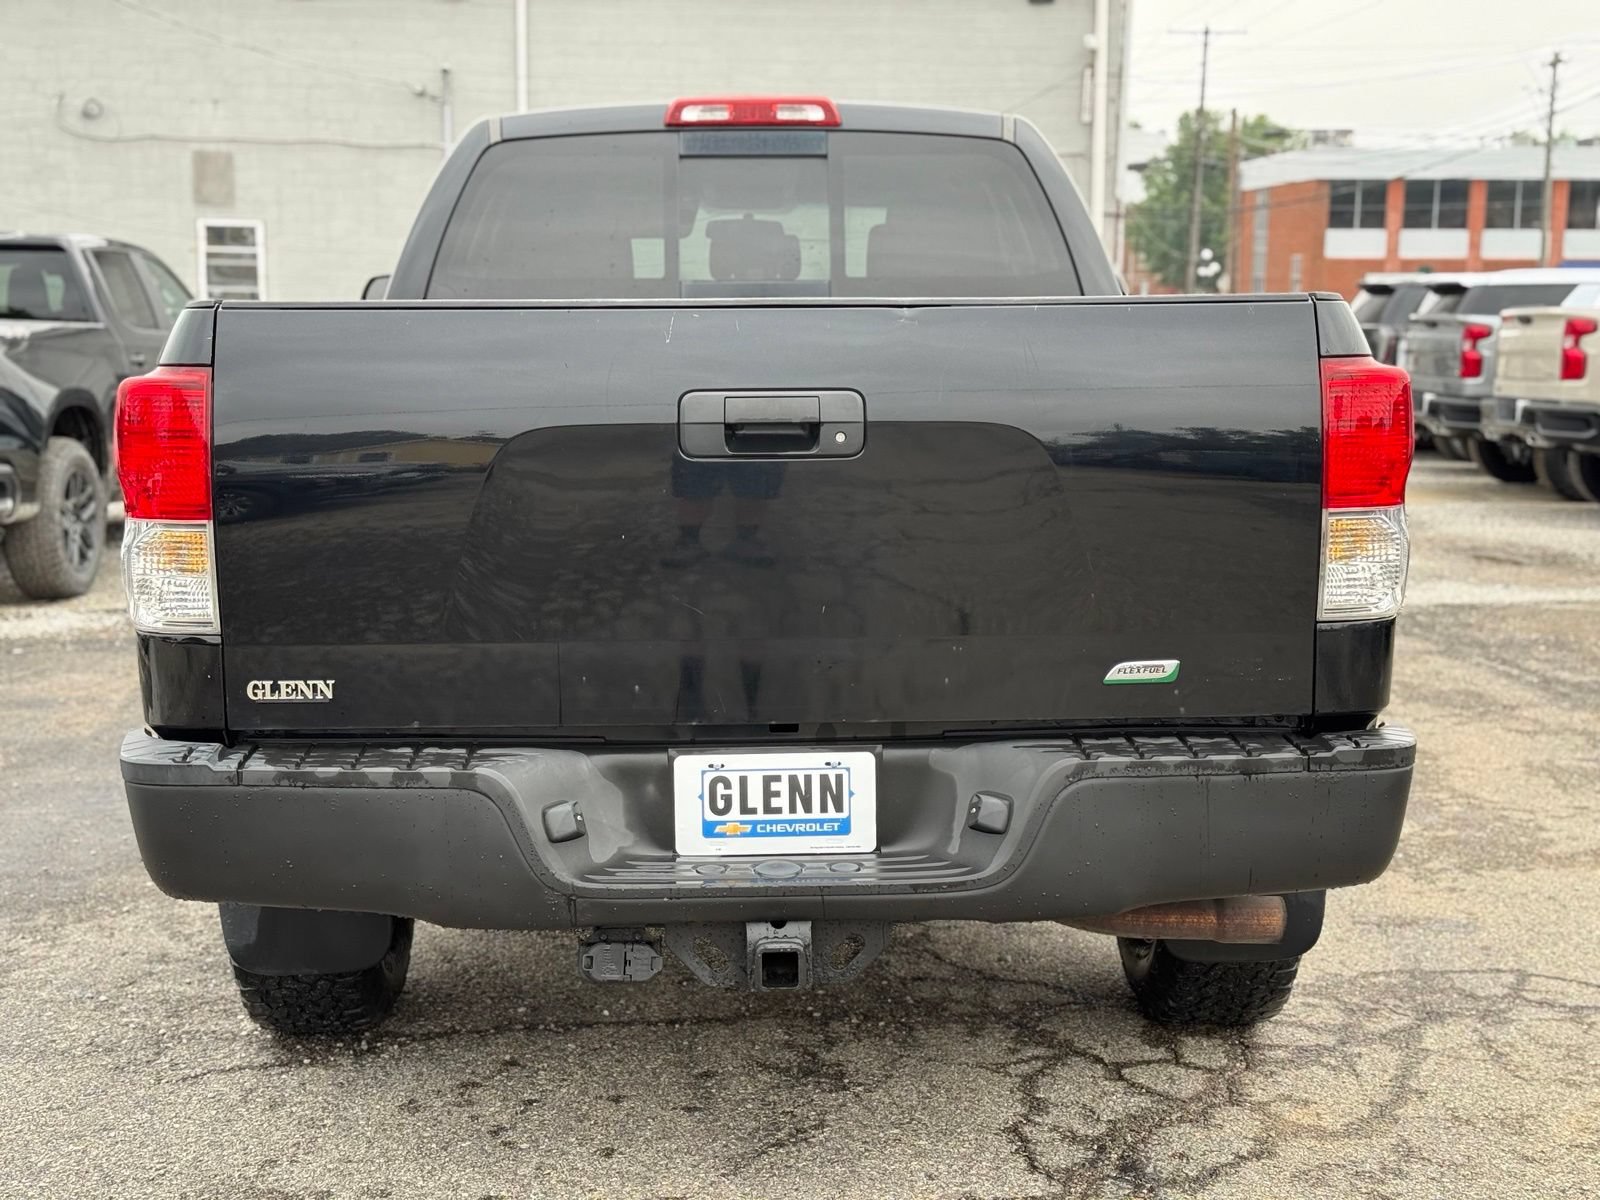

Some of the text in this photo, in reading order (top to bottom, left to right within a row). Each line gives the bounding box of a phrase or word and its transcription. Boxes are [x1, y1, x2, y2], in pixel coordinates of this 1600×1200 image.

[246, 680, 335, 700] GLENN
[708, 773, 844, 816] GLENN
[756, 822, 841, 833] CHEVROLET
